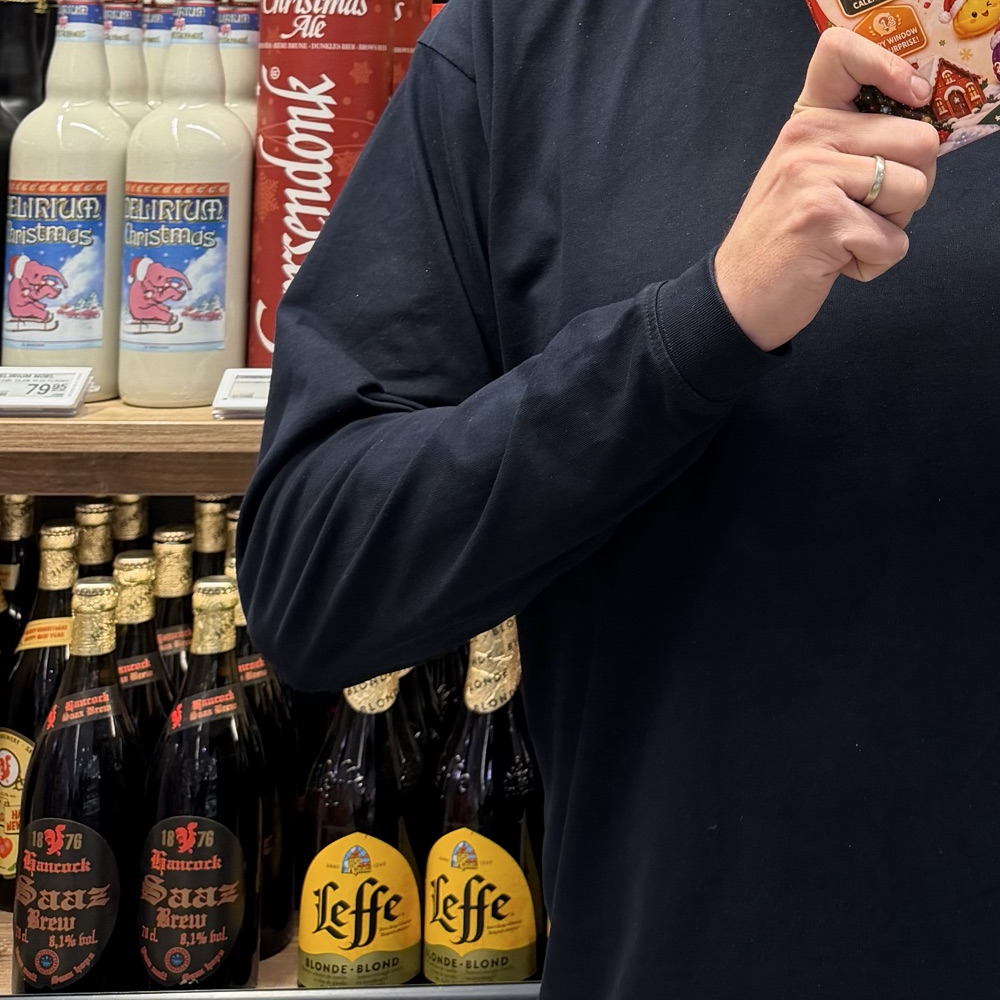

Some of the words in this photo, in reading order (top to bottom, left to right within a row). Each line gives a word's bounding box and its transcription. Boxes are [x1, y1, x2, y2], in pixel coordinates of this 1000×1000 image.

[279, 14, 327, 39] Ale
[880, 15, 897, 31] 13
[886, 27, 918, 45] WINDOW
[26, 383, 51, 395] 79
[31, 831, 43, 848] 18
[66, 833, 82, 849] 76
[161, 830, 174, 847] 18
[197, 830, 214, 847] 76
[23, 849, 91, 876] Hancock
[151, 848, 222, 876] Hancock
[15, 874, 111, 911] Saaz
[141, 874, 240, 910] Saaz
[27, 908, 76, 931] Brew
[157, 908, 207, 929] Brew
[312, 876, 402, 950] Leffe
[430, 873, 511, 944] Leffe
[305, 957, 348, 974] BLONDE
[356, 957, 400, 973] BLOND
[465, 956, 509, 969] BLOND
